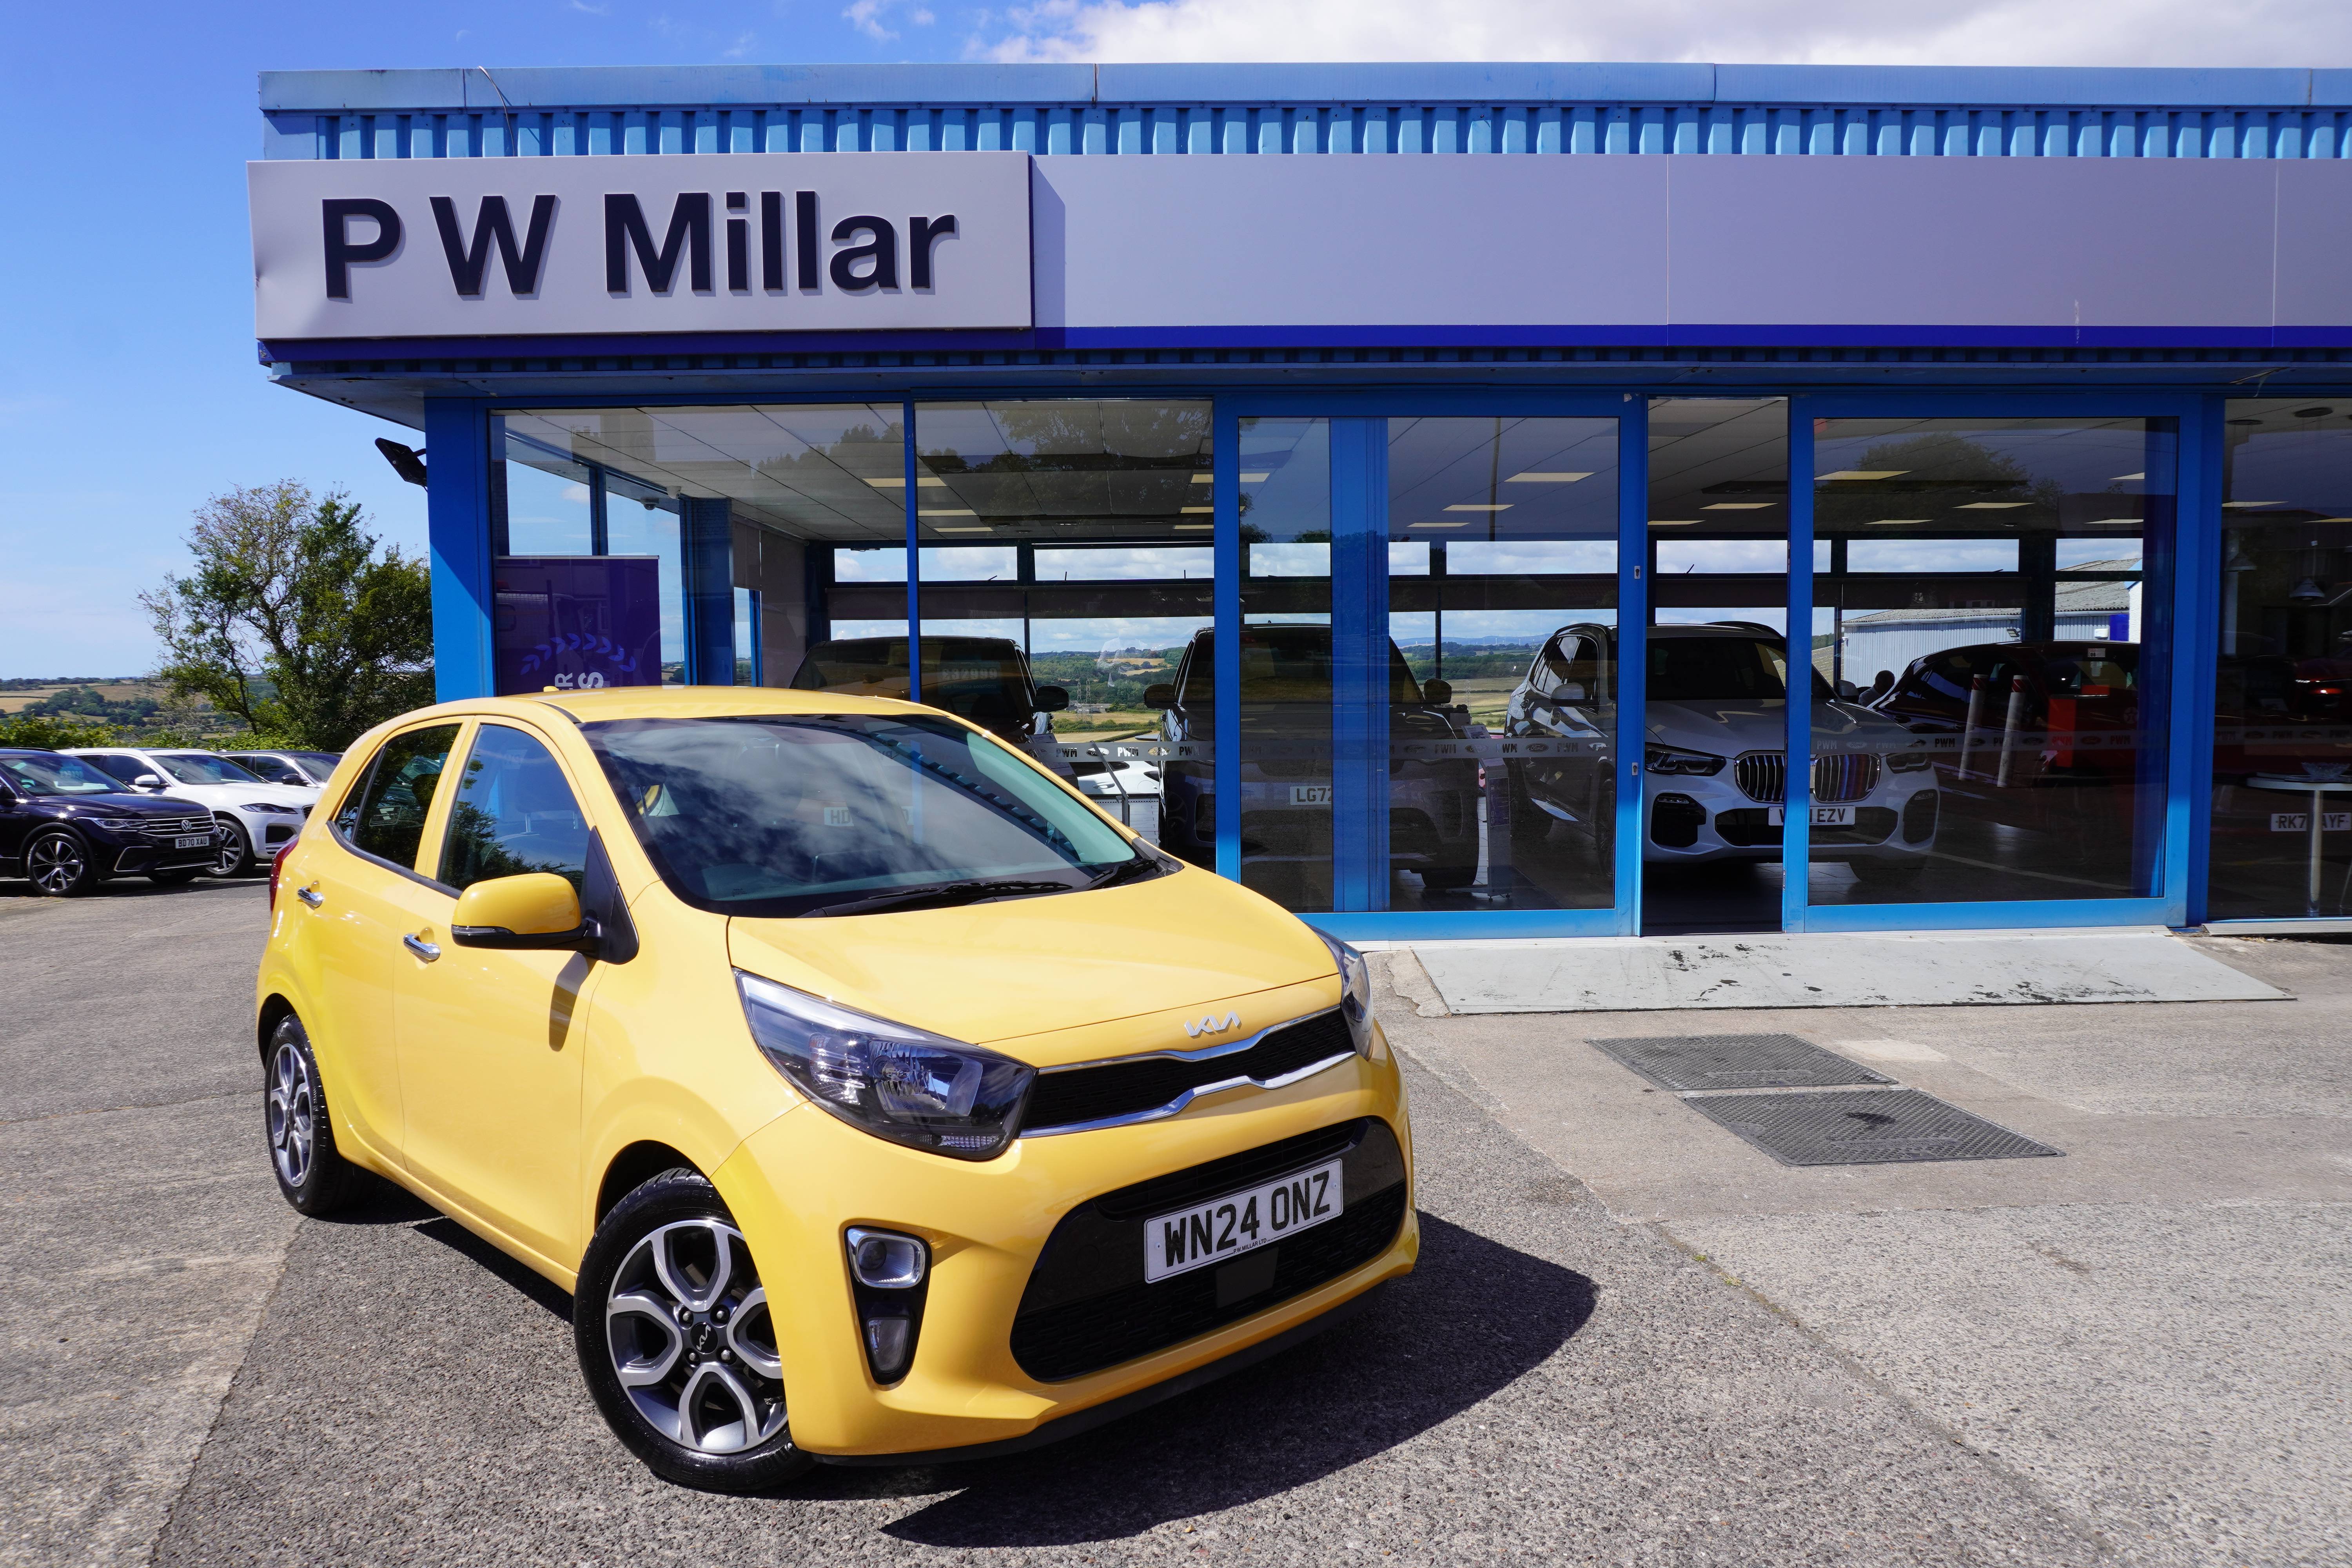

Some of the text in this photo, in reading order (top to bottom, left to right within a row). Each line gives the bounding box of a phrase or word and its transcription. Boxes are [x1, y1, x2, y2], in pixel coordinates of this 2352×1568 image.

[321, 191, 956, 298] P W Millar
[1817, 740, 1838, 750] PWM
[1935, 738, 1955, 748] PWM
[2110, 735, 2130, 744] PWM
[1117, 747, 1138, 757] PWM
[1817, 808, 1846, 822] EZV
[178, 838, 194, 847] BD70
[1164, 1170, 1330, 1267] WN24 ONZ
[1234, 1241, 1258, 1254] P.W.MILLAR
